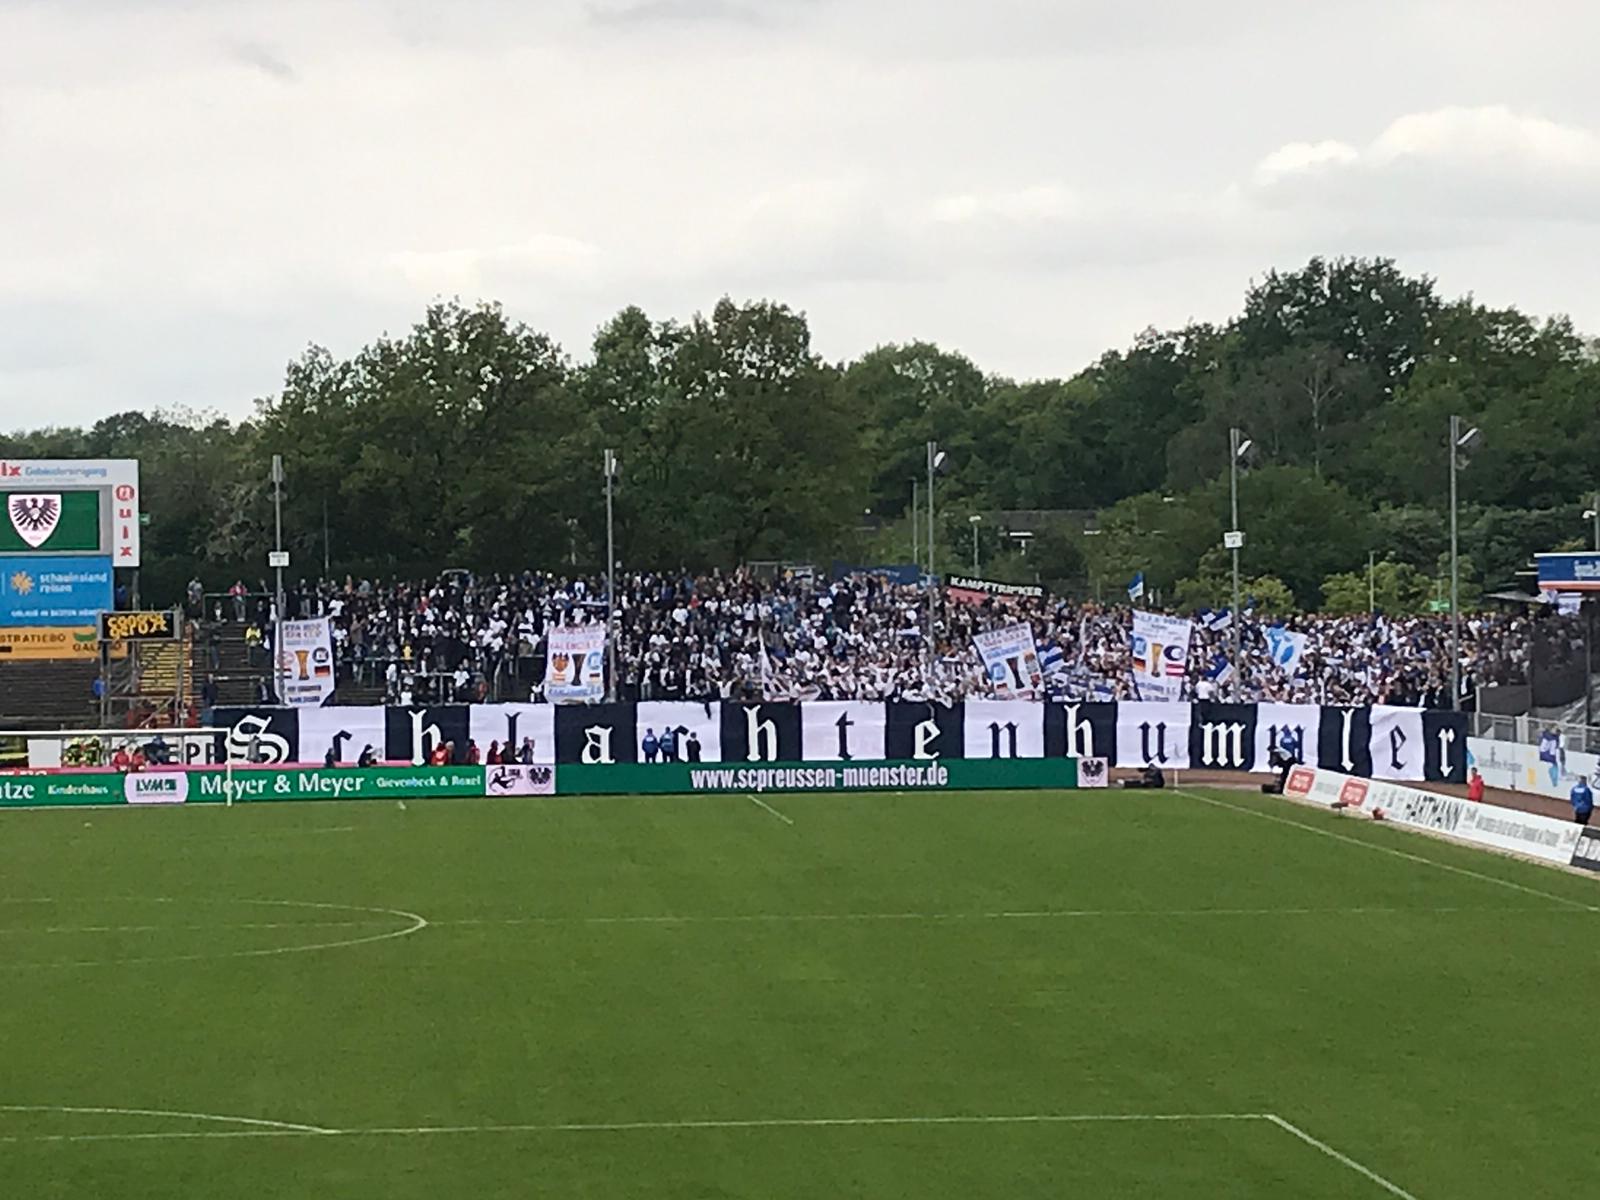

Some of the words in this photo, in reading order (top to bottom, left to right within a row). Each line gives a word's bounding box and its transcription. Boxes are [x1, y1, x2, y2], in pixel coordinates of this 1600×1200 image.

[201, 774, 267, 799] Meyer
[273, 773, 292, 794] &
[308, 772, 365, 798] Meyer
[690, 761, 949, 791] www.scpreussen-muenster.de
